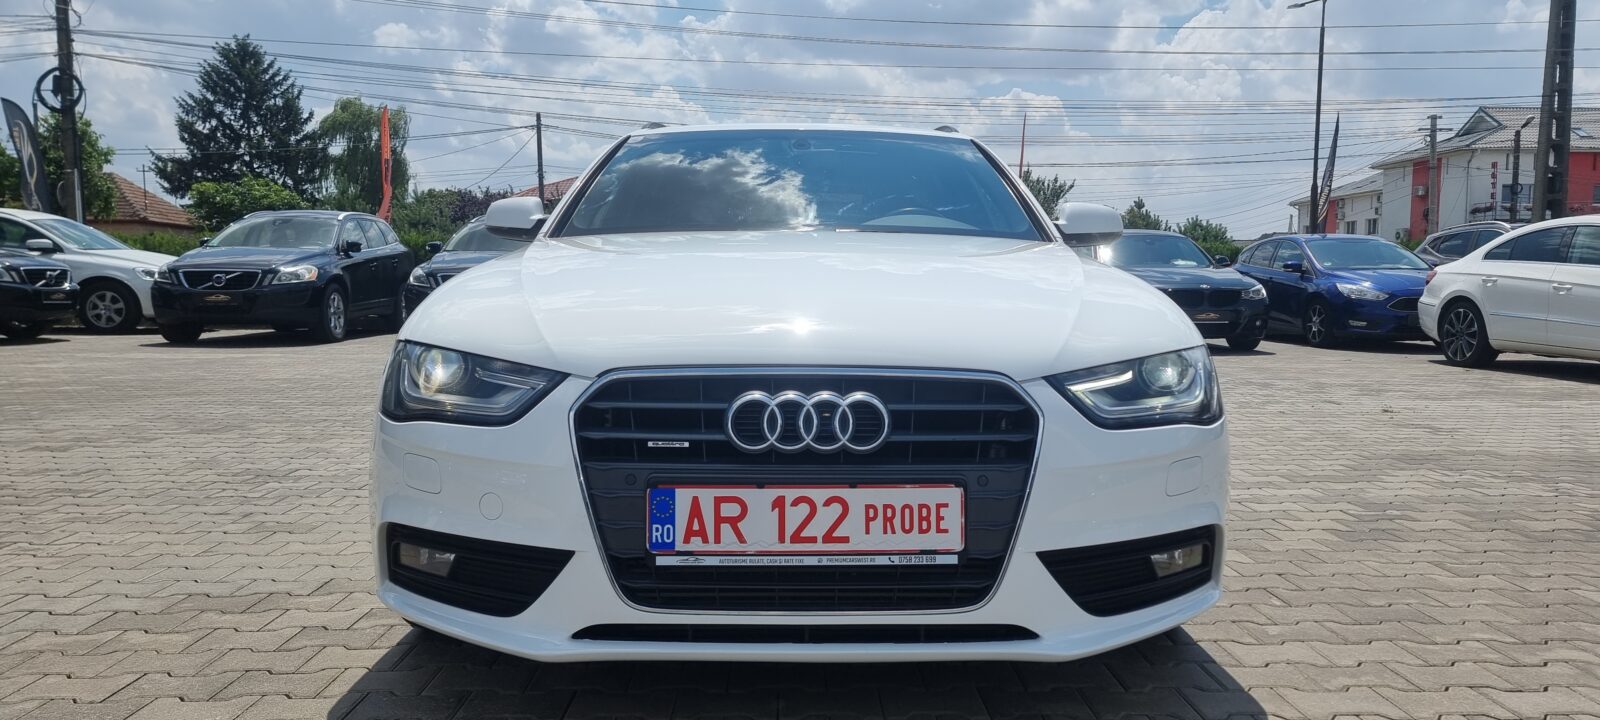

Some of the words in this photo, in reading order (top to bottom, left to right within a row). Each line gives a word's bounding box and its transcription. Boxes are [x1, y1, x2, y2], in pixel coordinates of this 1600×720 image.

[682, 495, 748, 545] AR
[771, 495, 850, 544] 122
[864, 503, 949, 535] PROBE
[652, 524, 674, 543] RO
[898, 556, 913, 564] 0758
[913, 556, 924, 564] 233
[925, 556, 937, 564] 699
